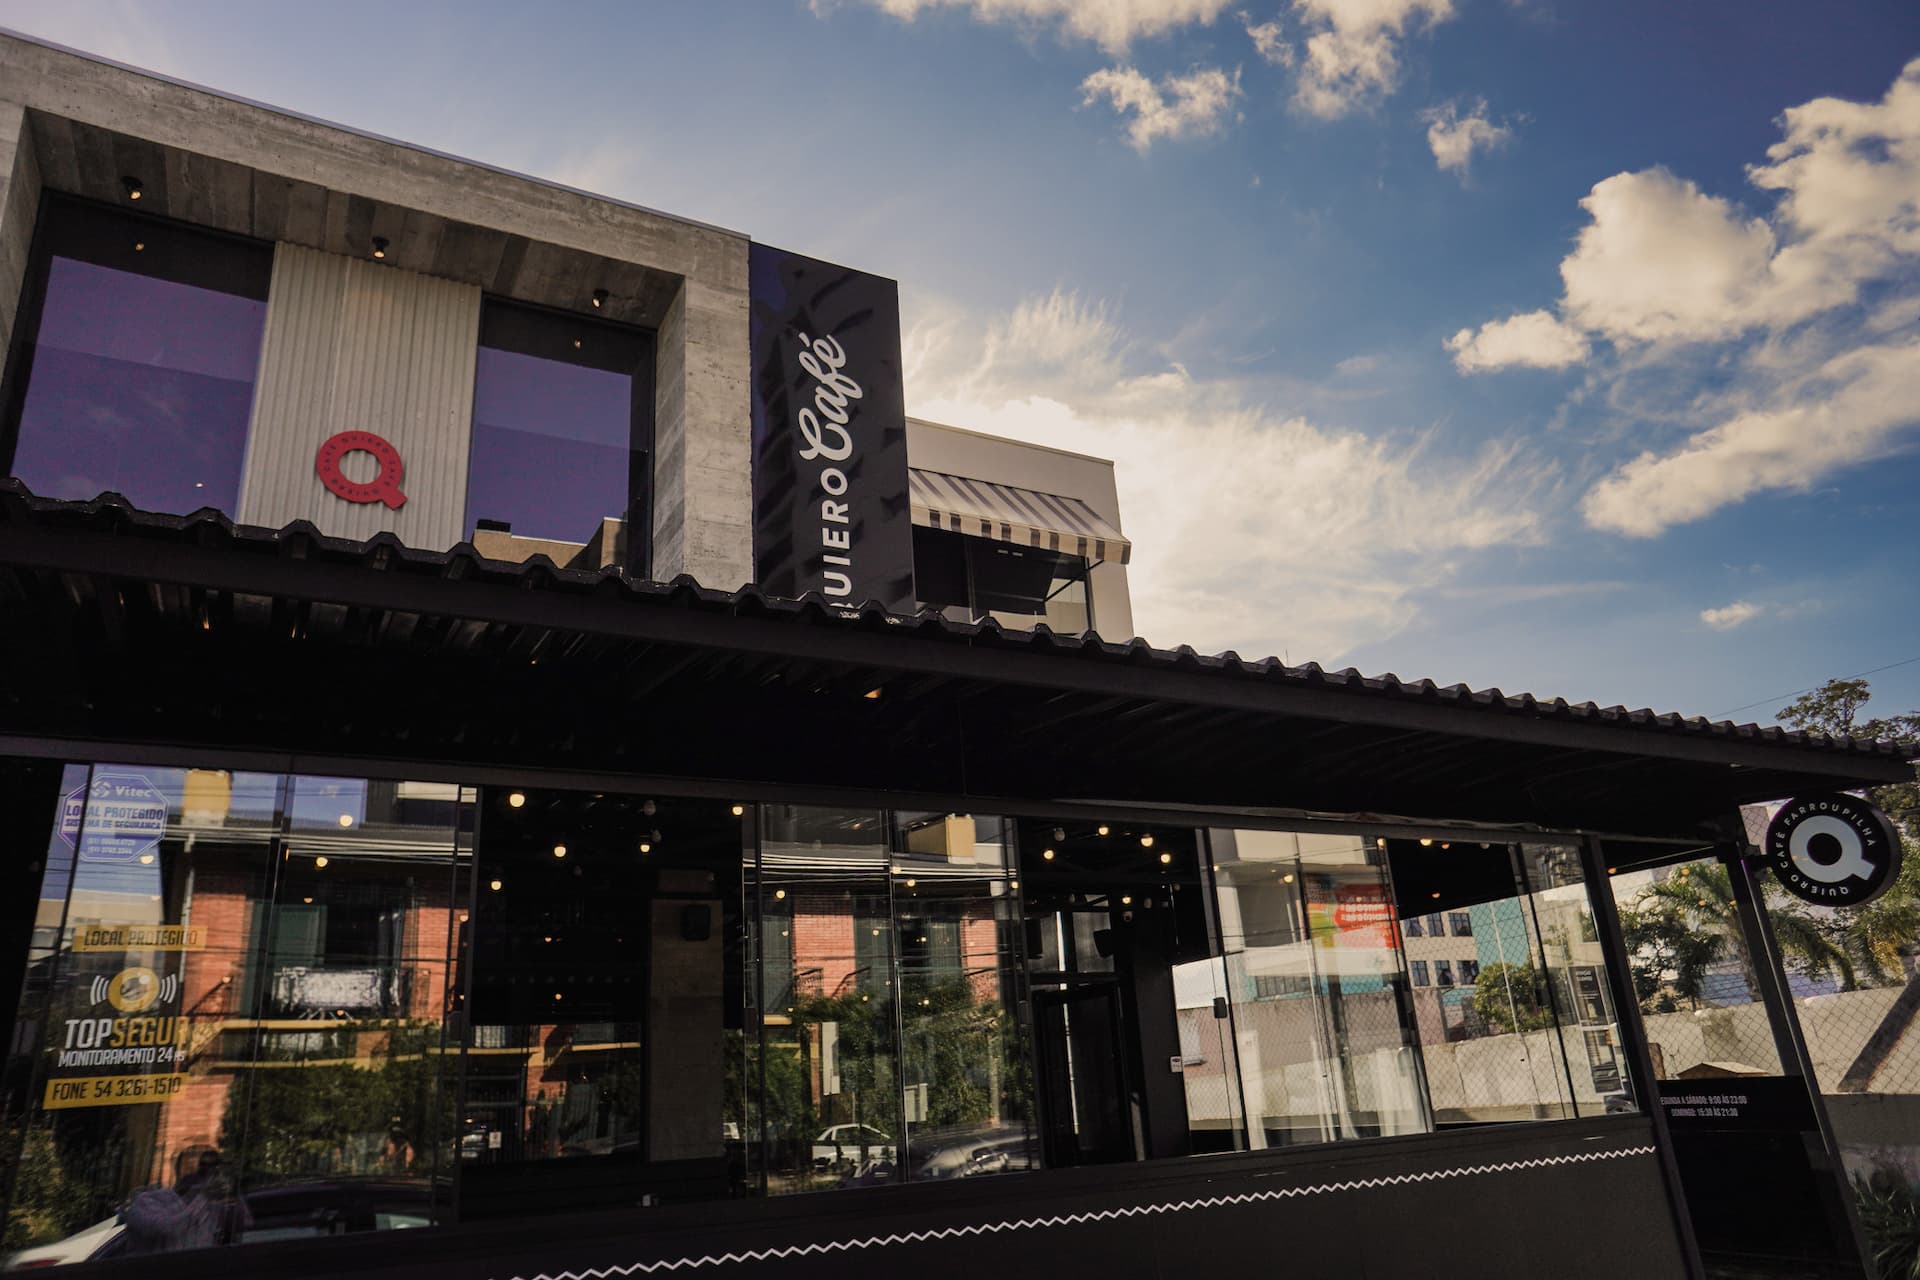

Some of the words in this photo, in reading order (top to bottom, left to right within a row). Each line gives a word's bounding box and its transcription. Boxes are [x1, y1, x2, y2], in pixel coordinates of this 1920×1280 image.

[798, 332, 863, 462] Café
[820, 468, 854, 608] UIERO
[115, 786, 151, 797] Vitec
[66, 805, 101, 817] LOAL
[104, 806, 164, 820] PROTEGIDO
[1784, 802, 1876, 848] FARROUPILHA
[1775, 831, 1789, 869] CAFÉ
[1789, 815, 1876, 883] Q
[1790, 873, 1849, 896] QUIERO
[84, 930, 123, 946] LOCAL
[58, 1048, 155, 1067] MONITORAMENTO
[52, 1082, 89, 1100] FONE
[94, 1080, 112, 1098] 54
[115, 1077, 182, 1097] 3261-1510
